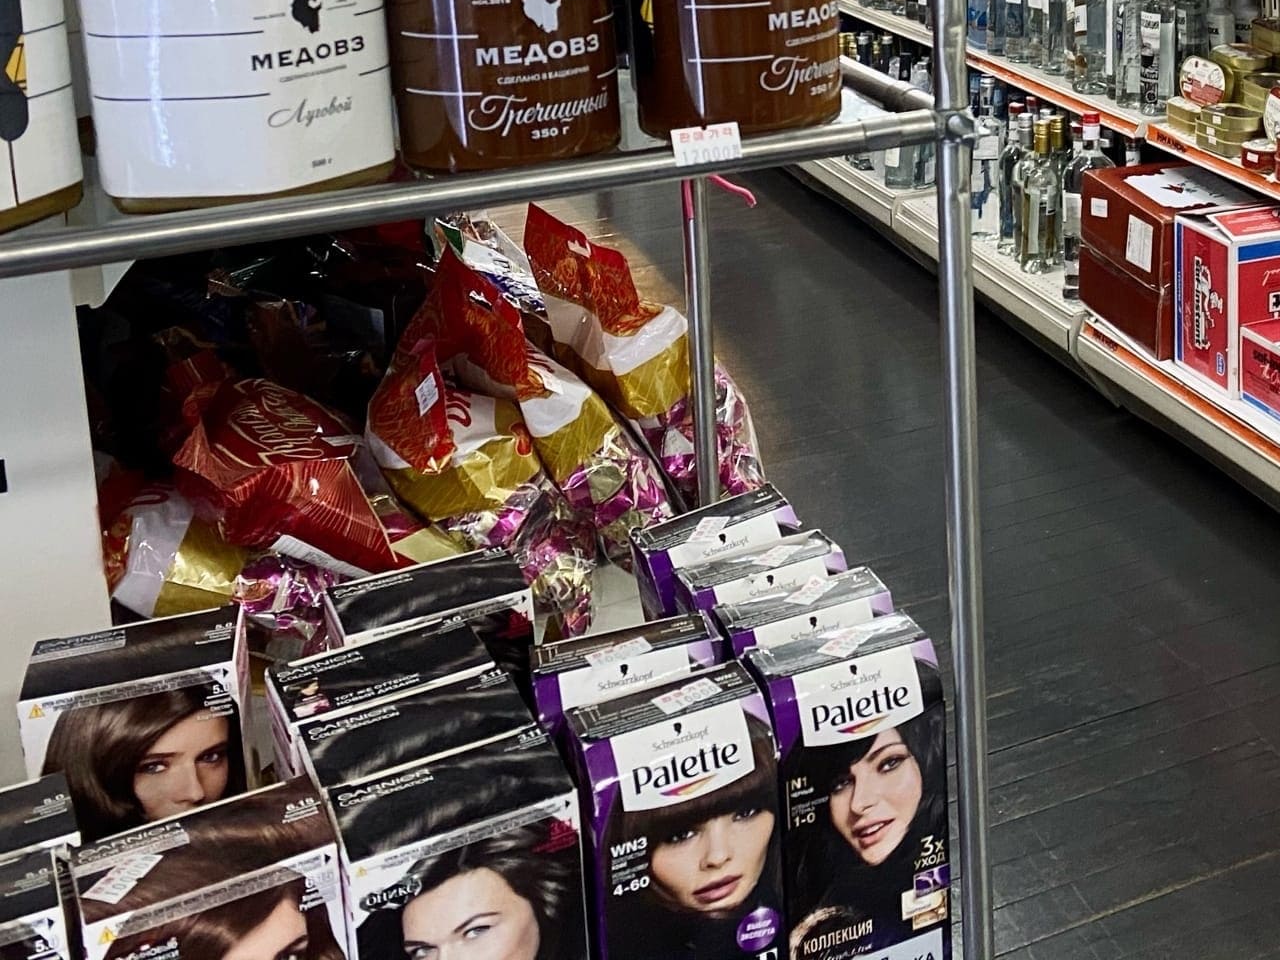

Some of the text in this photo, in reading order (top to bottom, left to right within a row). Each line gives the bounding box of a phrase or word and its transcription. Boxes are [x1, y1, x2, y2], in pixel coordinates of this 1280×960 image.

[252, 36, 364, 71] МЕДОВЗ
[476, 34, 600, 66] МЕДОВЗ
[531, 127, 558, 140] 350
[276, 650, 361, 679] GARNIER
[598, 670, 654, 691] Schwarzkopf
[308, 705, 398, 736] GARNIER
[812, 686, 910, 732] Palette
[632, 742, 740, 796] Palette
[338, 768, 430, 802] GARNIER
[610, 836, 648, 858] WN3
[914, 853, 946, 870] УХОД
[612, 876, 650, 897] 4-60
[803, 919, 873, 956] КОЛЛЕКЦИЯ
